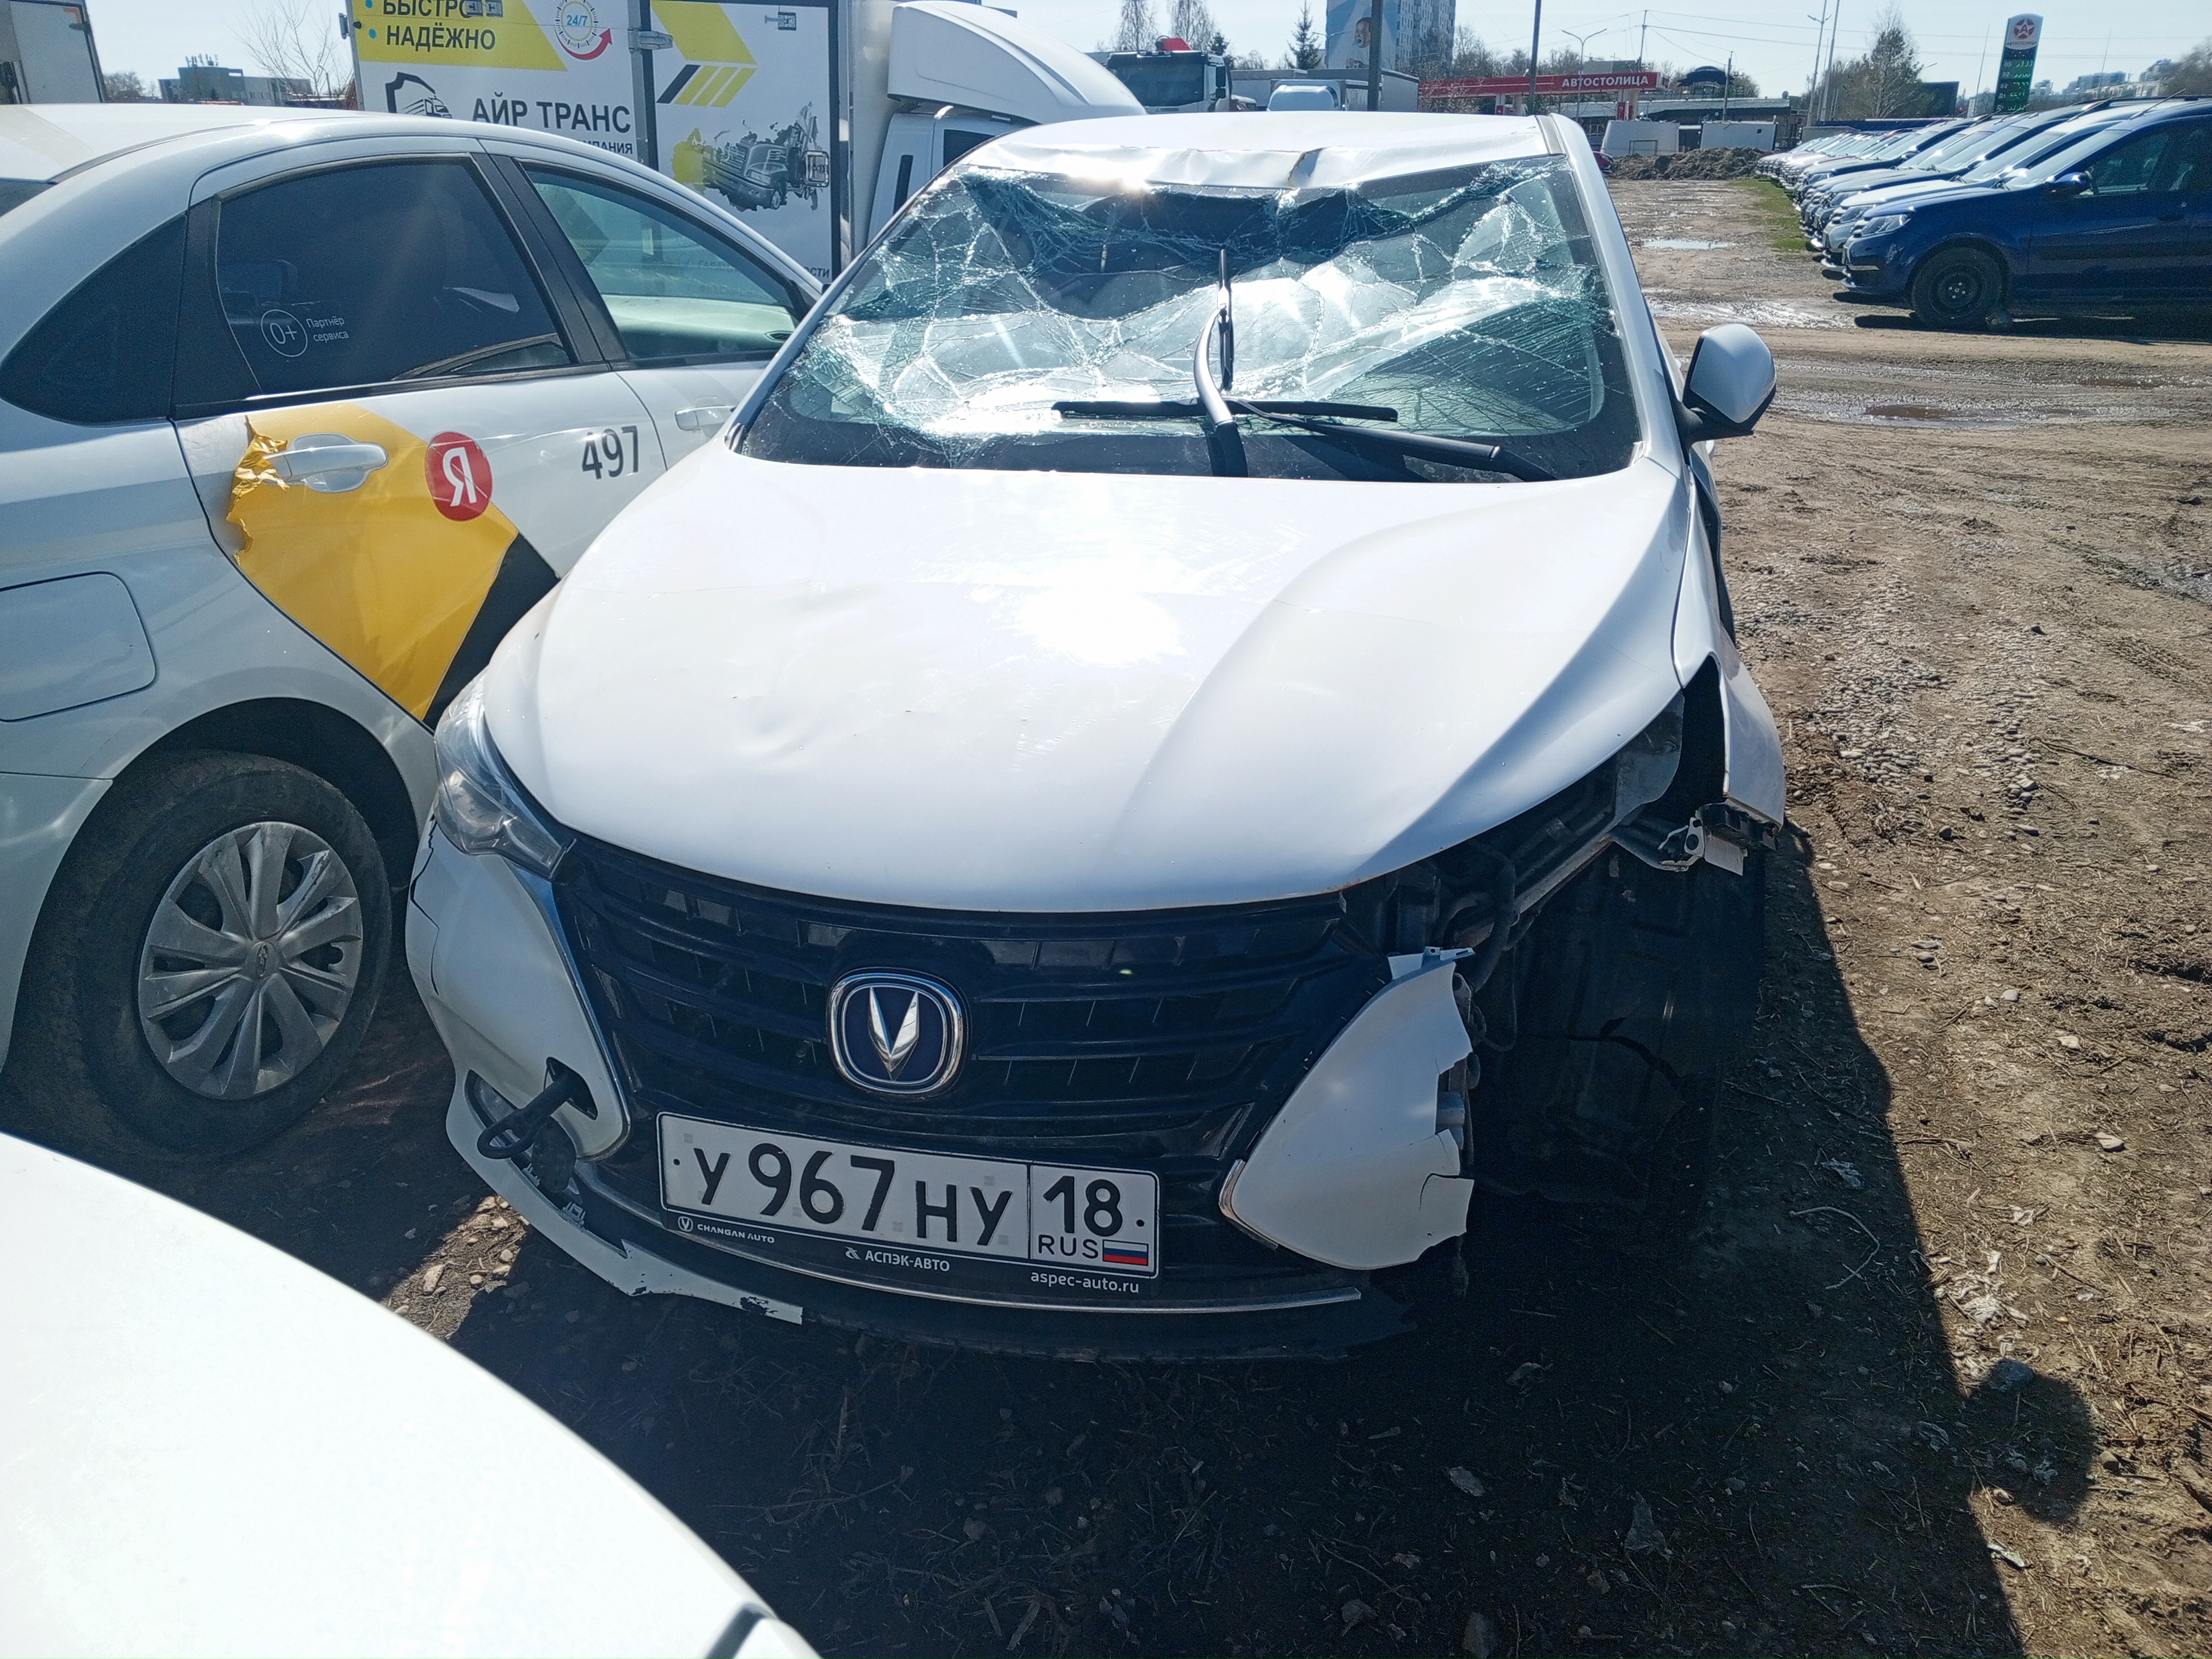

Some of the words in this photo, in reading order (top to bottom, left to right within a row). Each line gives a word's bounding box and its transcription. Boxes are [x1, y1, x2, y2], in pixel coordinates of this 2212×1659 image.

[567, 15, 588, 27] 24/7
[387, 22, 495, 52] НАДЁЖНО
[1562, 76, 1649, 87] АВТОСТОЛИЦА
[472, 91, 528, 126] АЙР
[536, 101, 631, 133] ТРАНС
[306, 316, 345, 329] Партнёр
[269, 323, 297, 345] 0+
[313, 331, 349, 343] сервиса
[582, 425, 638, 480] 497
[443, 446, 477, 507] Я
[1043, 1176, 1123, 1237] 18
[697, 1224, 746, 1239] CHANGAN
[747, 1233, 775, 1244] AUTO
[1039, 1234, 1099, 1259] RUS
[865, 1250, 950, 1272] АСПЭК-АВТО
[1030, 1272, 1139, 1293] aspec-auto.ru
